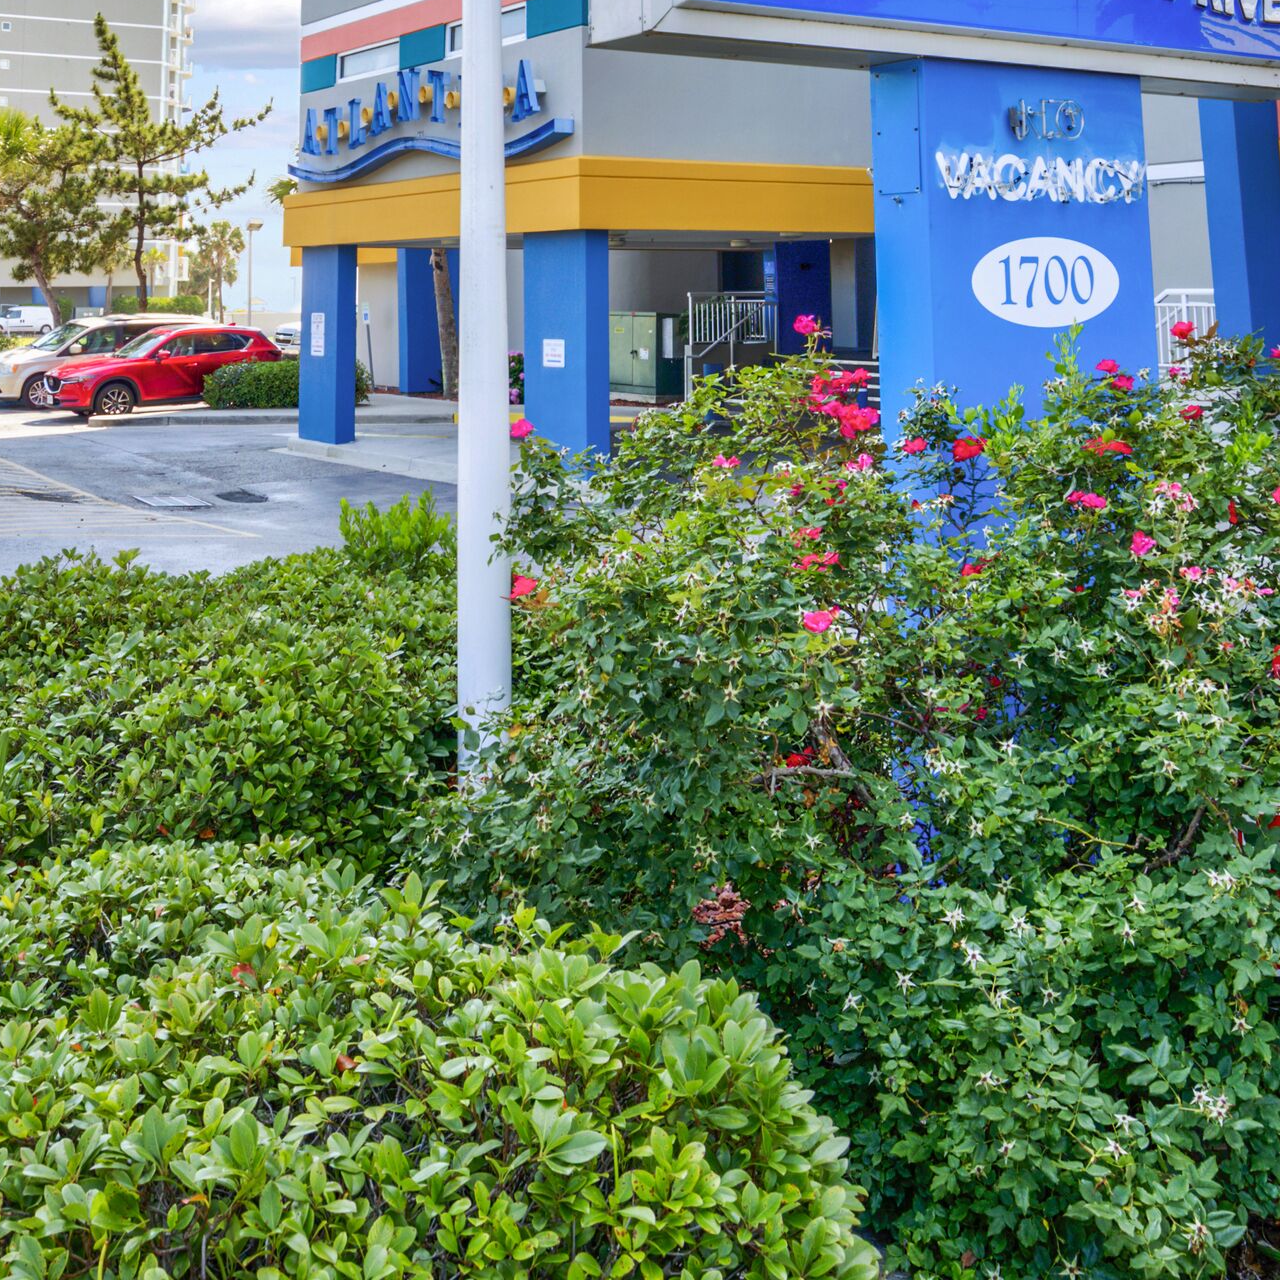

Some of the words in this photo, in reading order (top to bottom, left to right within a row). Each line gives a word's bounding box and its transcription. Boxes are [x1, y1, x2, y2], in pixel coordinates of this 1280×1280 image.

[301, 58, 541, 156] ATLANTA
[935, 151, 1143, 204] VACANCY
[998, 255, 1095, 309] 1700
